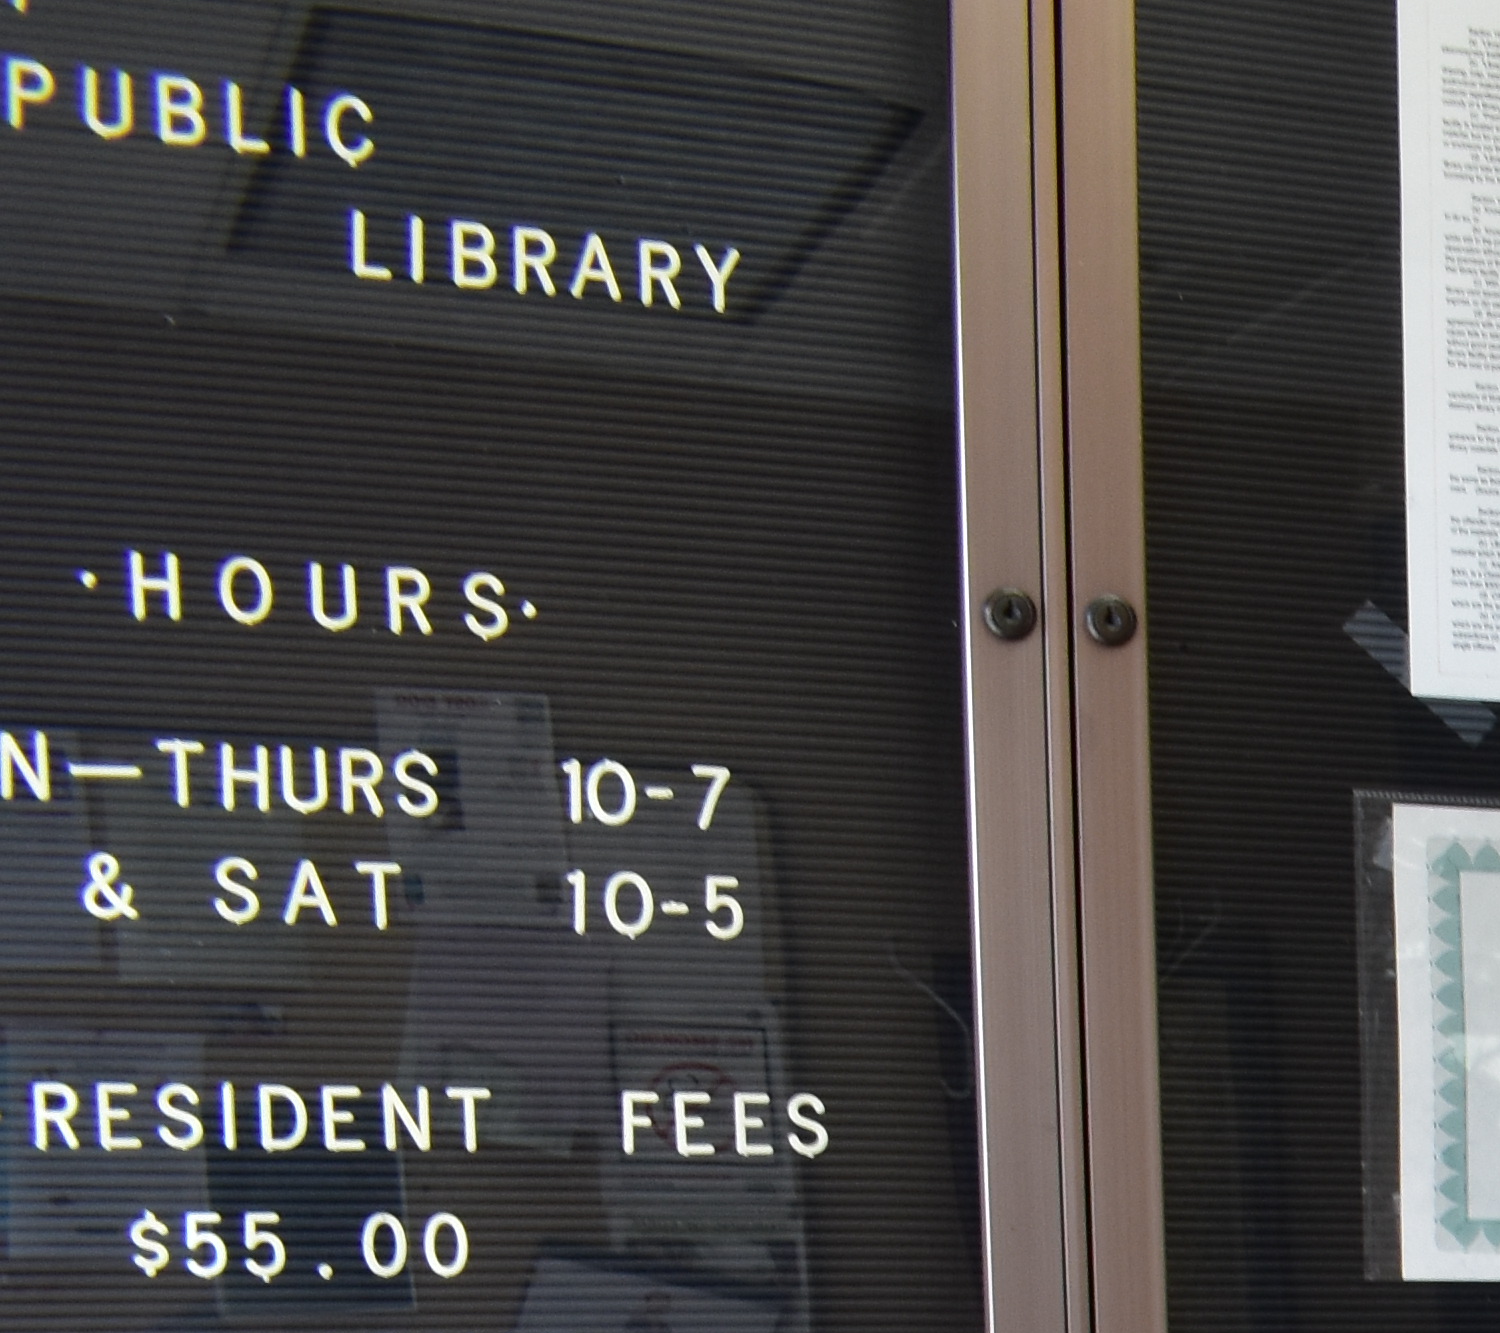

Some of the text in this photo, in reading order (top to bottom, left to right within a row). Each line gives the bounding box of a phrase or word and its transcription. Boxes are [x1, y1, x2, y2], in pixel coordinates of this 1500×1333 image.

[3, 56, 377, 167] PUBLIC
[349, 208, 740, 314] LIBRARY
[562, 757, 731, 830] 10-7
[80, 851, 744, 942] & SAT 10-5
[30, 1080, 830, 1159] RESIDENT FEES
[129, 1209, 471, 1282] $55.00
